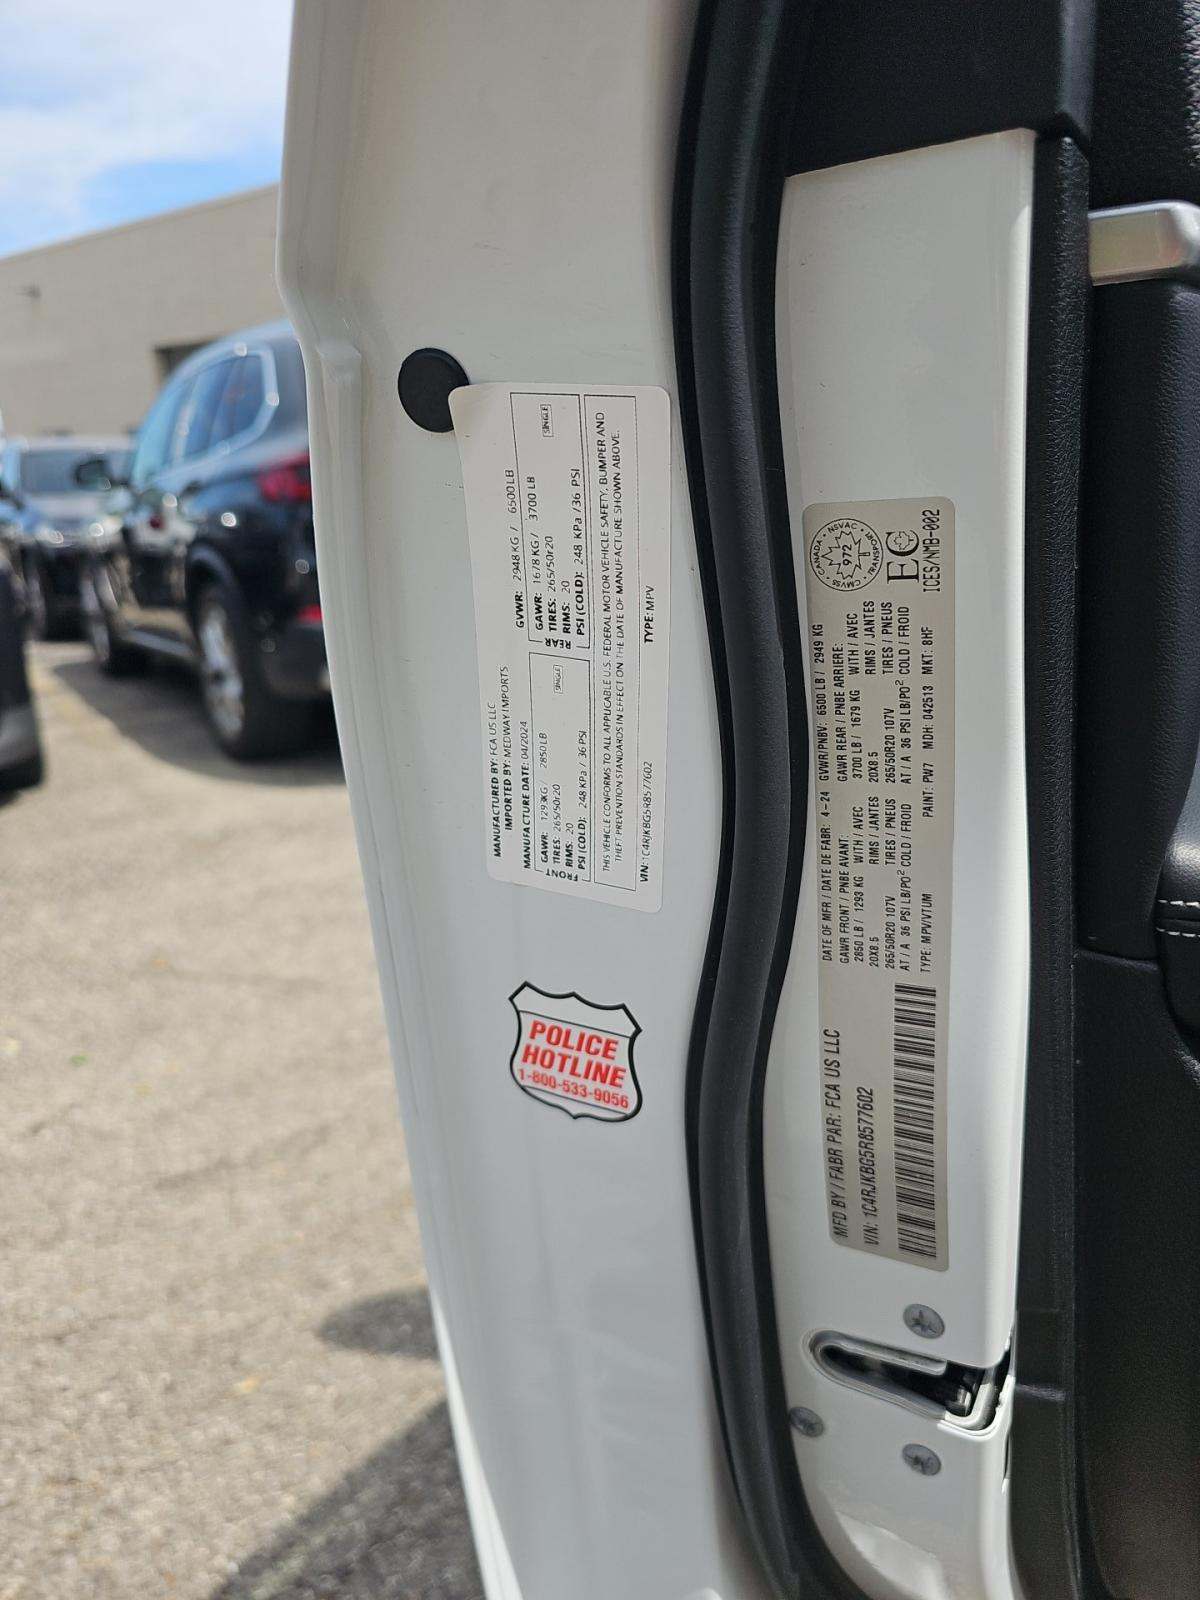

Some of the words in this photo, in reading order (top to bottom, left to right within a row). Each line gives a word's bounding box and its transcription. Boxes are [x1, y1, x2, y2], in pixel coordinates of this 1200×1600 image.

[596, 412, 605, 437] AND
[597, 439, 607, 484] BUMPER
[506, 469, 514, 484] LB
[527, 476, 536, 490] LB
[571, 468, 580, 487] PSI
[507, 486, 517, 513] 6500
[613, 472, 622, 514] SHOWN
[528, 493, 538, 520] 3700
[573, 518, 582, 539] KPa
[511, 537, 520, 552] KG
[531, 541, 540, 556] KG
[574, 544, 583, 564] 248
[600, 531, 609, 572] VEHICLE
[614, 517, 624, 594] MANUFACTURE
[813, 539, 825, 575] CANADA
[842, 544, 852, 566] 972
[865, 531, 880, 576] TRANSPORT
[922, 509, 940, 592] ICES/NMB-002
[512, 554, 522, 581] 2948
[544, 536, 556, 592] 265/50r20
[561, 580, 570, 593] 20
[575, 572, 585, 615] (COLD):
[601, 575, 611, 612] MOTOR
[645, 586, 654, 611] MPV
[515, 591, 525, 628] GVWR:
[534, 593, 543, 631] GAWR:
[547, 598, 557, 632] TIRES:
[562, 602, 571, 634] RIMS:
[863, 601, 875, 638] JANTES
[881, 602, 892, 634] PNEUS
[898, 606, 909, 637] FROID
[576, 618, 584, 636] PSI
[602, 614, 611, 656] FEDERAL
[615, 613, 624, 639] DATE
[644, 613, 653, 643] TYPE:
[813, 624, 823, 636] KG
[847, 614, 858, 638] AVEC
[921, 626, 932, 645] 8HF
[545, 638, 571, 649] REAR
[814, 641, 824, 664] 2949
[832, 643, 844, 688] ARRIERE:
[848, 649, 859, 675] WITH
[865, 651, 876, 675] RIMS
[882, 647, 893, 674] TIRES
[899, 649, 910, 675] COLD
[922, 651, 933, 675] MKT:
[500, 666, 509, 712] IMPORTS
[814, 678, 825, 690] LB
[850, 690, 860, 701] KG
[488, 702, 496, 719] LLC
[603, 680, 611, 734] APPLICABLE
[815, 693, 826, 716] 6500
[834, 692, 845, 716] PNBE
[922, 685, 933, 720] 042513
[489, 723, 497, 735] US
[851, 706, 860, 727] 1679
[884, 708, 895, 730] 107V
[900, 718, 911, 733] PSI
[489, 738, 498, 755] FCA
[501, 715, 511, 757] MEDWAY
[520, 721, 528, 759] 04/2024
[539, 733, 547, 744] LB
[579, 730, 587, 745] PSI
[835, 726, 846, 751] REAR
[851, 742, 862, 754] LB
[901, 738, 912, 748] 36
[922, 724, 933, 749] MDH:
[579, 747, 586, 758] 36
[615, 727, 624, 779] STANDARDS
[816, 723, 830, 781] GVWR/PNBV:
[884, 735, 896, 784] 265/50R20
[490, 758, 498, 774] BY:
[503, 760, 511, 776] BY:
[521, 762, 529, 791] DATE:
[837, 755, 848, 782] GAWR
[852, 757, 862, 779] 3700
[869, 752, 878, 783] 20X8.5
[900, 773, 911, 784] AT
[923, 763, 934, 783] PW7
[579, 771, 587, 788] KPa
[603, 768, 611, 816] CONFORMS
[504, 779, 512, 830] IMPORTED
[578, 790, 586, 808] 248
[922, 788, 933, 817] PAINT:
[491, 777, 501, 857] MANUFACTURED
[853, 807, 863, 829] AVEC
[868, 796, 878, 831] JANTES
[885, 798, 895, 828] PNEUS
[900, 804, 911, 832] FROID
[522, 793, 531, 869] MANUFACTURE
[566, 823, 573, 834] 20
[578, 817, 587, 853] (COLD):
[603, 819, 611, 852] VEHICLE
[820, 824, 831, 852] FABR:
[578, 855, 586, 869] PSI
[839, 835, 849, 868] AVANT:
[853, 840, 863, 863] WITH
[869, 841, 879, 865] RIMS
[885, 840, 895, 865] TIRES
[900, 843, 911, 867] COLD
[546, 869, 578, 881] FRONT
[640, 862, 648, 882] VIN:
[821, 868, 831, 891] DATE
[839, 871, 849, 893] PNBE
[854, 876, 864, 887] KG
[821, 902, 832, 921] MFR
[854, 891, 864, 912] 1293
[885, 896, 895, 917] 107V
[839, 904, 850, 935] FRONT
[900, 907, 910, 922] PSI
[921, 893, 932, 944] MPV/VTUM
[854, 926, 864, 938] LB
[900, 926, 910, 936] 36
[822, 938, 832, 961] DATE
[840, 938, 850, 963] GAWR
[854, 941, 864, 962] 2850
[869, 936, 879, 967] 20X8.5
[885, 922, 895, 969] 265/50R20
[900, 960, 910, 971] AT
[921, 948, 931, 973] TYPE:
[529, 1020, 619, 1060] POLICE
[823, 1029, 839, 1054] LLC
[522, 1043, 626, 1088] HOTLINE
[824, 1059, 840, 1078] US
[518, 1068, 629, 1108] 1-800-533-9056
[825, 1084, 840, 1108] FCA
[826, 1115, 842, 1144] PAR:
[828, 1148, 844, 1181] FABR
[830, 1193, 845, 1208] BY
[832, 1213, 848, 1237] MFD
[862, 1223, 879, 1245] VIN:
